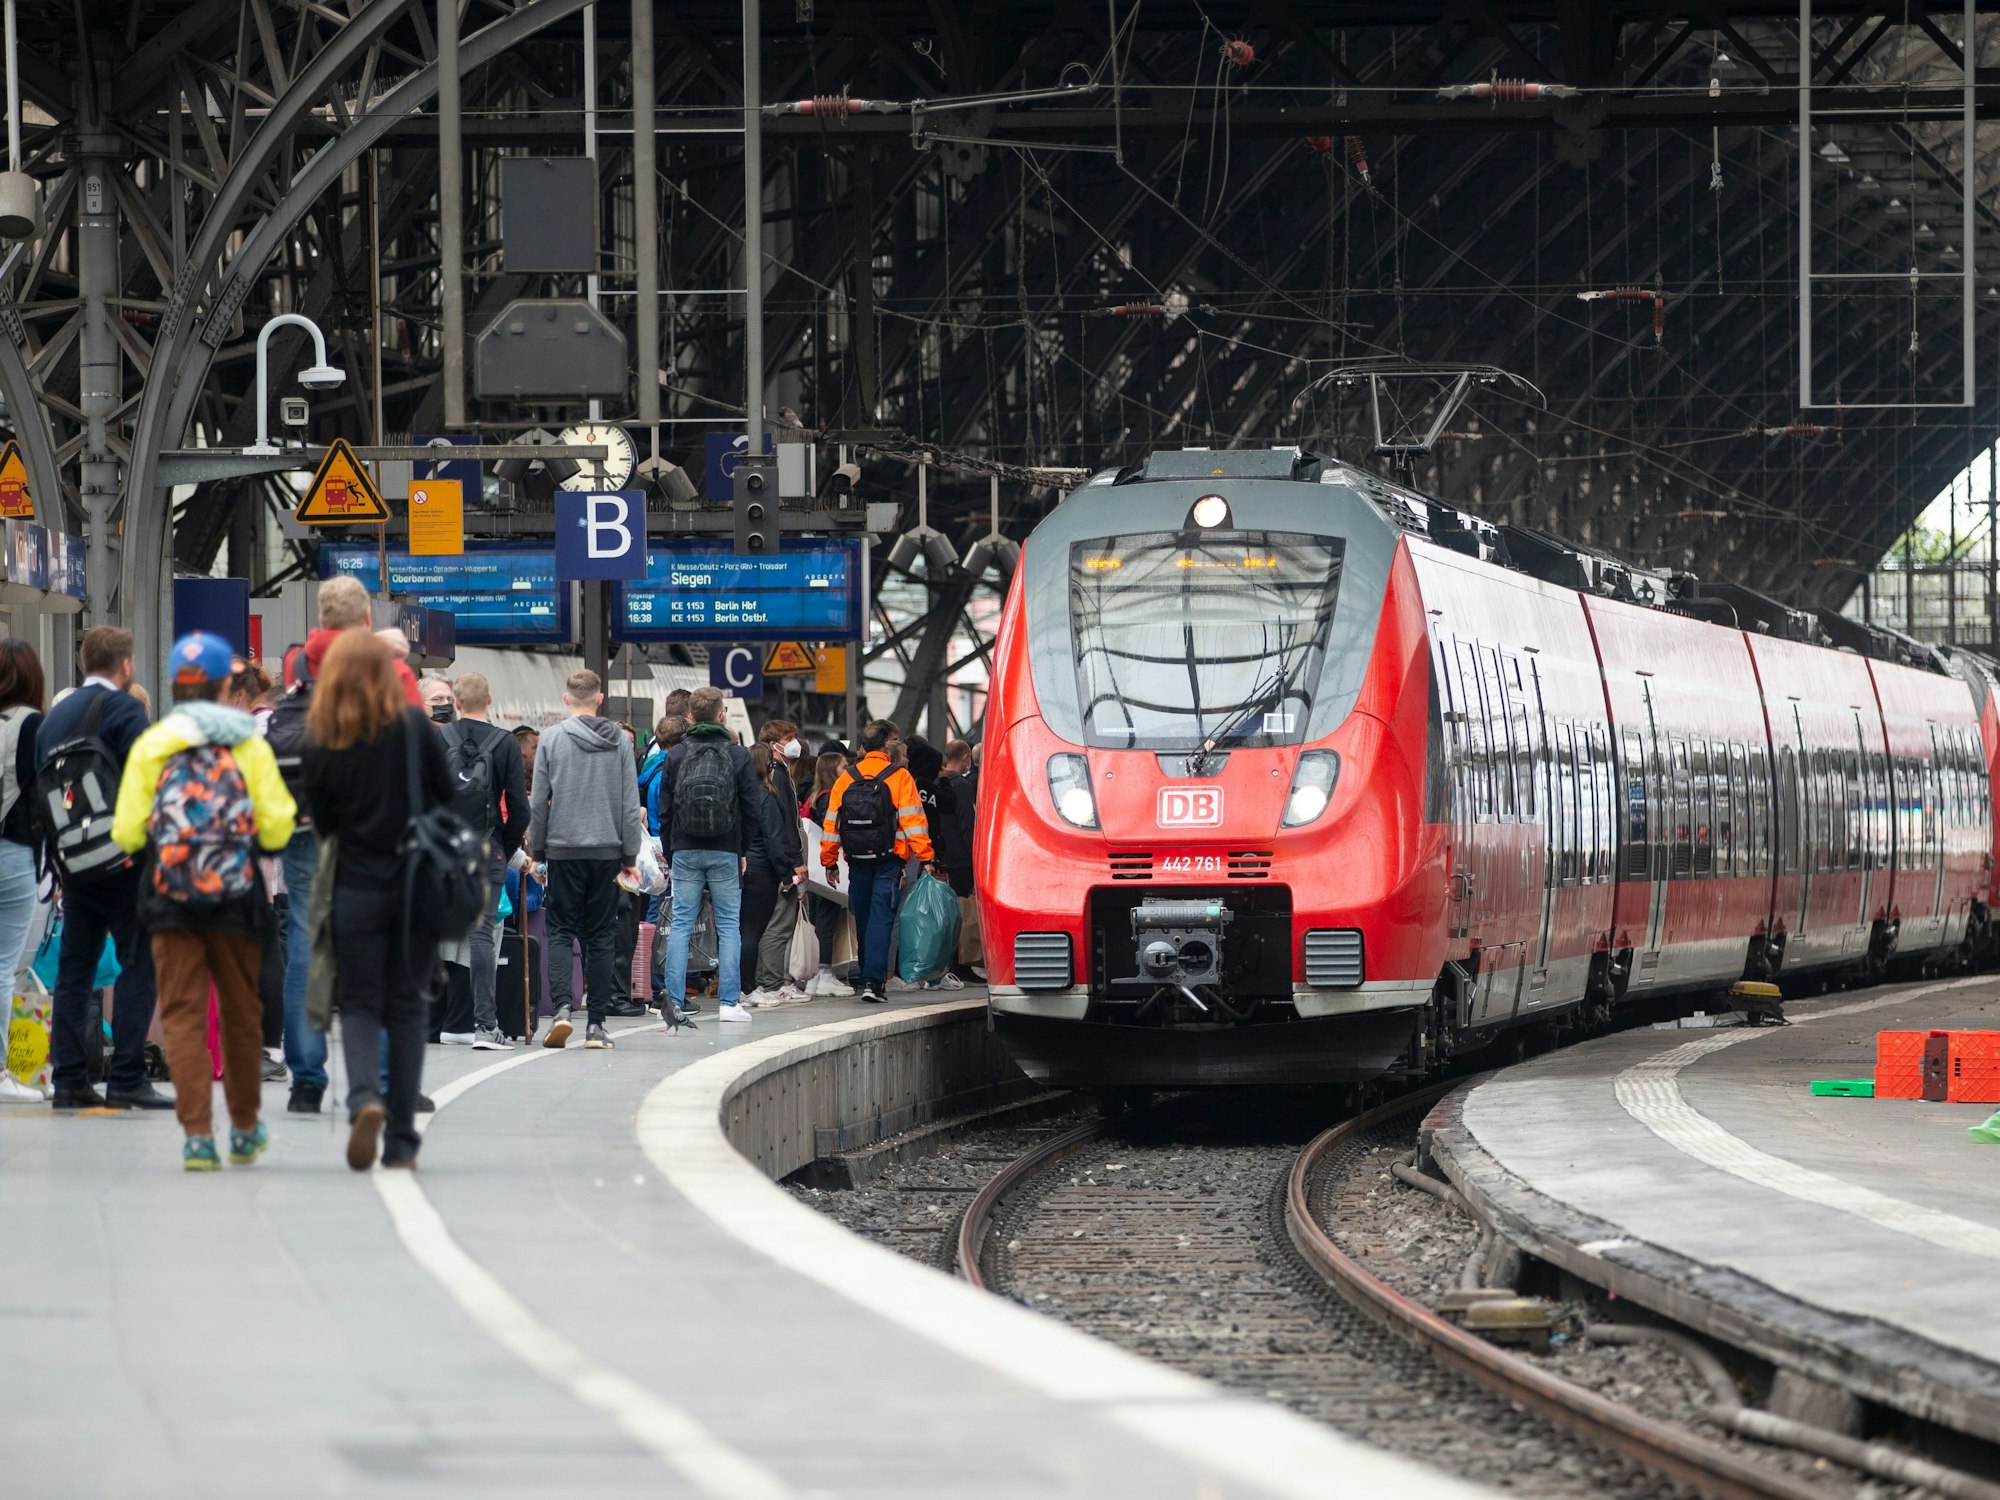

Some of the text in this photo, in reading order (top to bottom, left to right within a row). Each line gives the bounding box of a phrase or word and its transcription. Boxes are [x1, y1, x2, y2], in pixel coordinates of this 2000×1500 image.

[87, 183, 101, 192] 951
[586, 495, 632, 559] B
[337, 558, 363, 569] 16:25
[759, 562, 787, 570] Troisdorf
[464, 565, 497, 574] Wuppertal
[392, 574, 443, 584] Oberbarmen
[671, 572, 711, 588] Siegen
[628, 601, 756, 610] 16:38 ICE 1153 Berlin Hbf
[628, 613, 768, 622] 16:38 ICE 1153 Berlin Ostbf.
[725, 647, 754, 688] C
[1166, 793, 1215, 821] DB
[1162, 856, 1221, 871] 442 761
